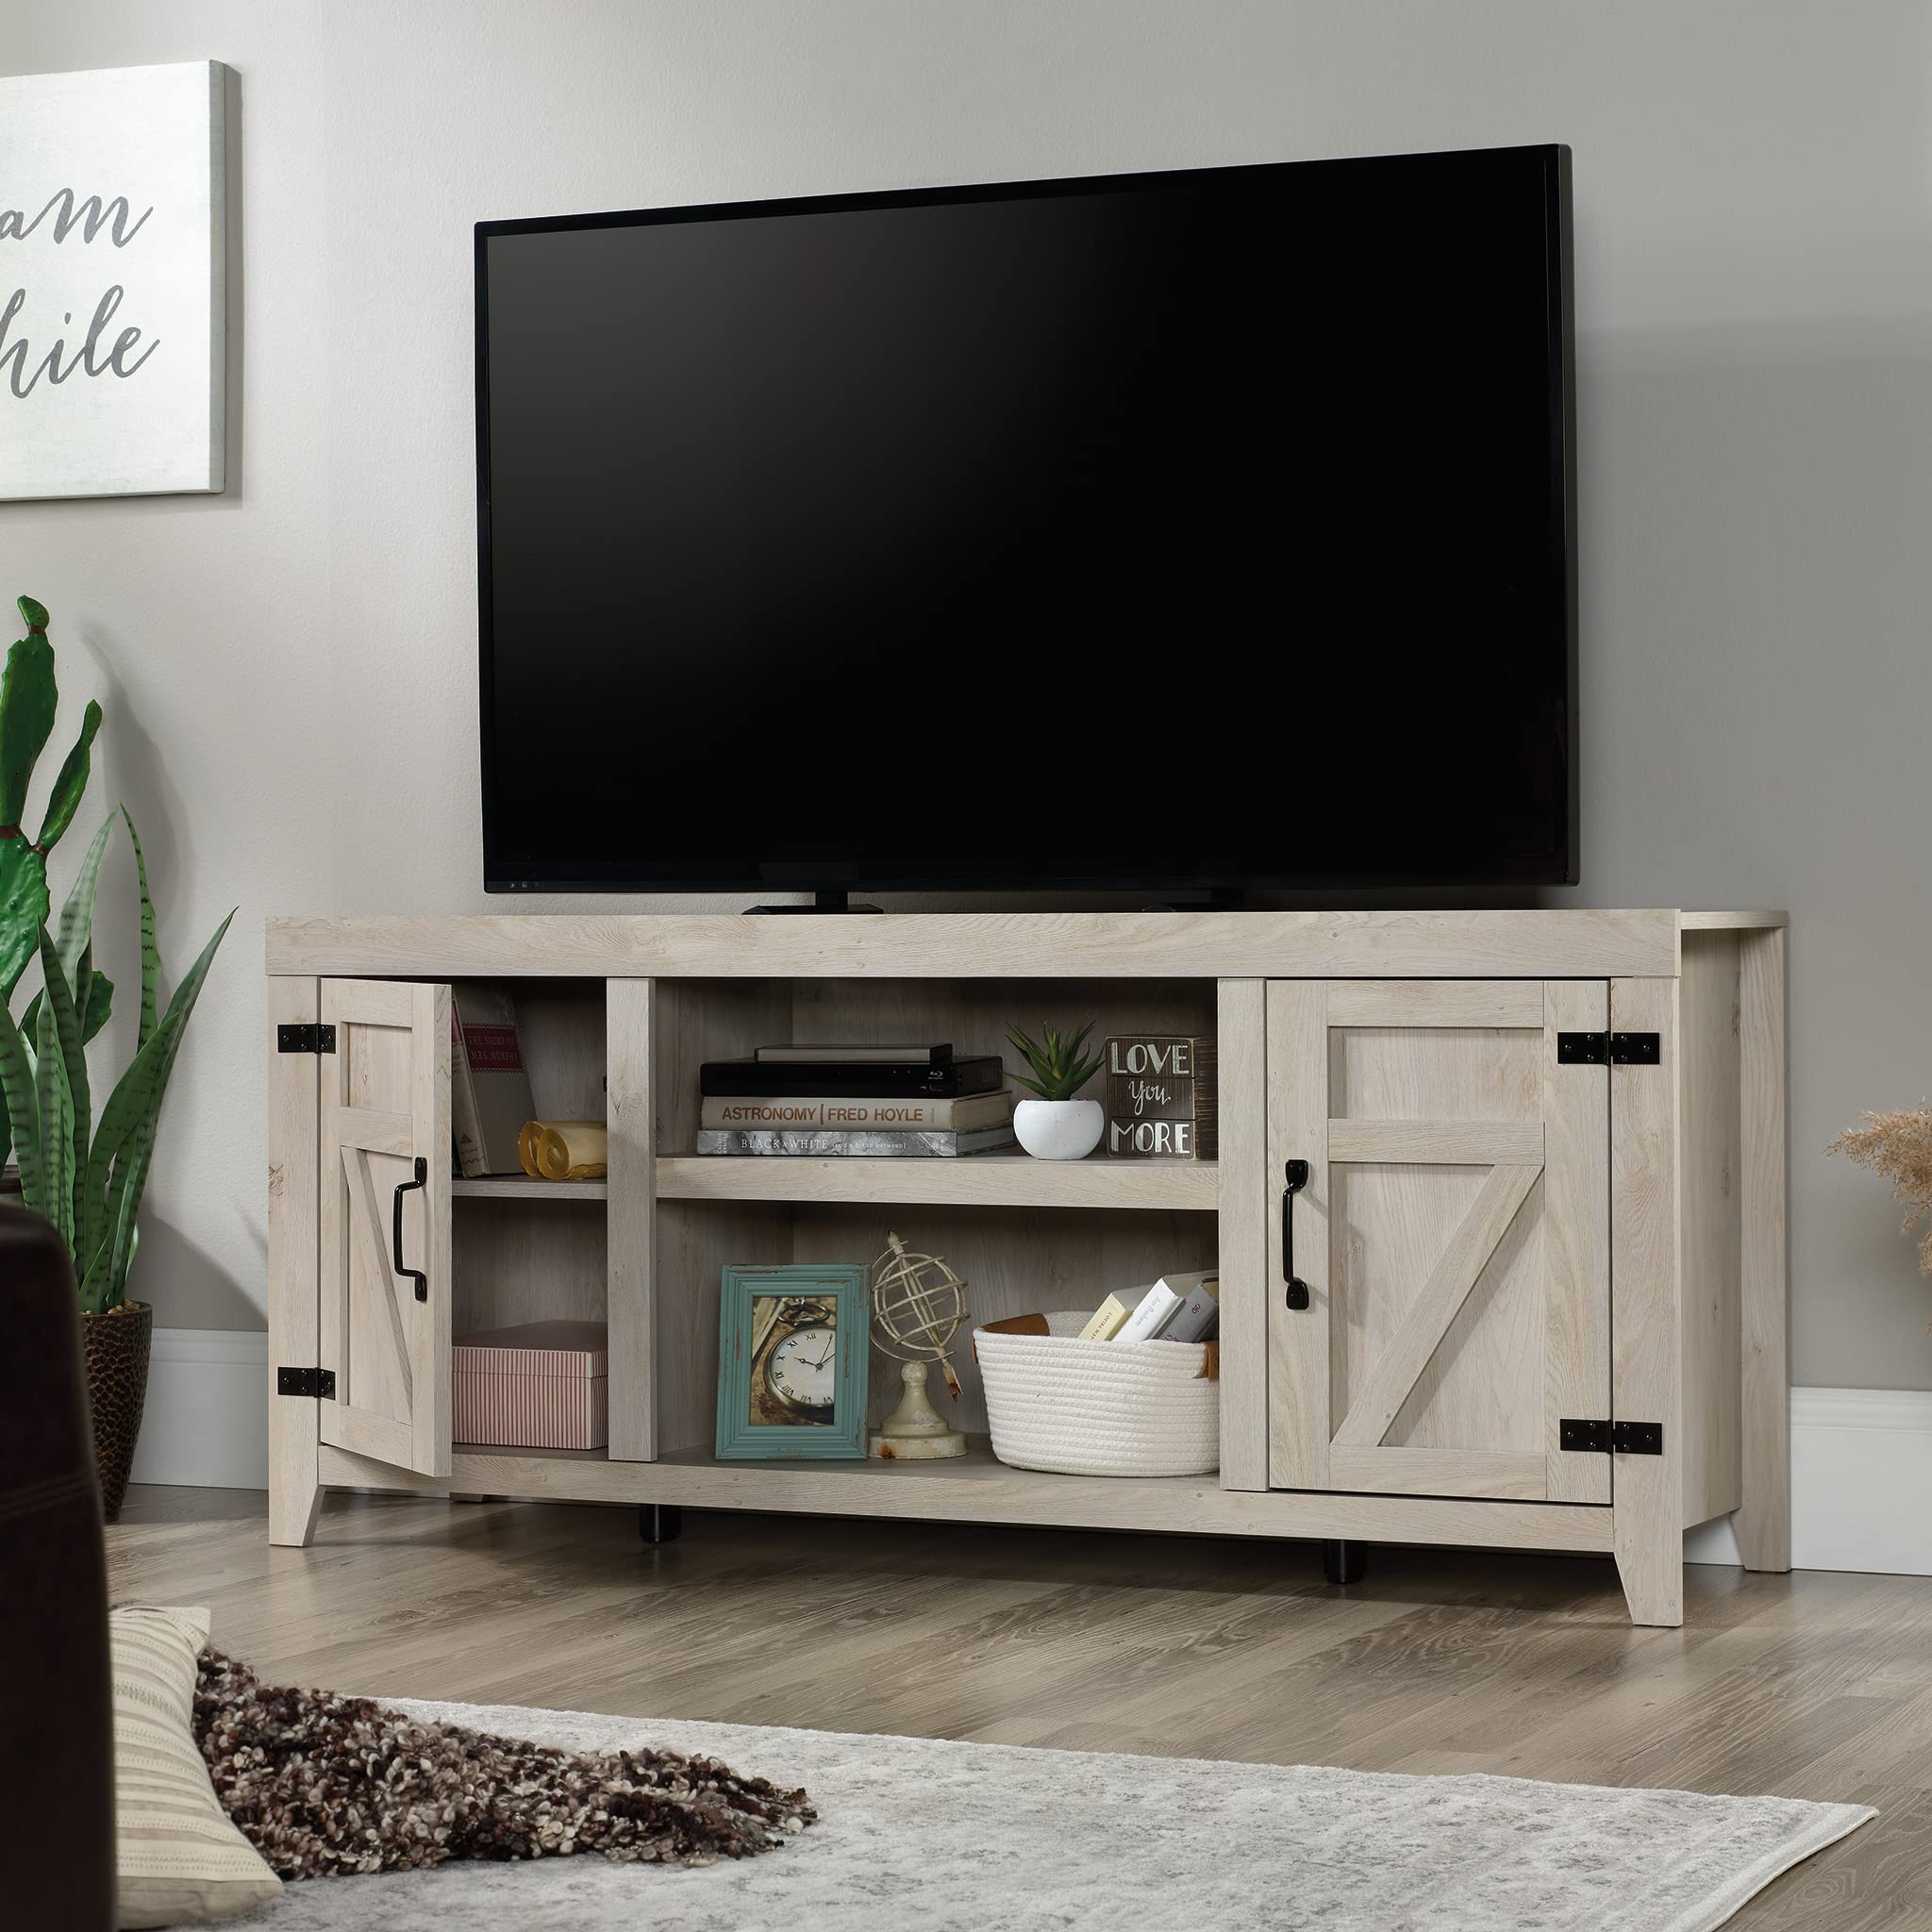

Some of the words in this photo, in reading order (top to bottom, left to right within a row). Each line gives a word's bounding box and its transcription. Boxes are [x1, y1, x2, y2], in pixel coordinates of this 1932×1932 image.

[468, 1036, 483, 1045] THE
[1111, 1041, 1190, 1074] LOVE
[722, 1107, 817, 1121] ASTRONOMY
[827, 1108, 868, 1122] FRED
[874, 1108, 924, 1122] HOYLE
[741, 1139, 780, 1149] BLACK
[789, 1139, 828, 1149] WHITE
[1110, 1121, 1191, 1154] MORE
